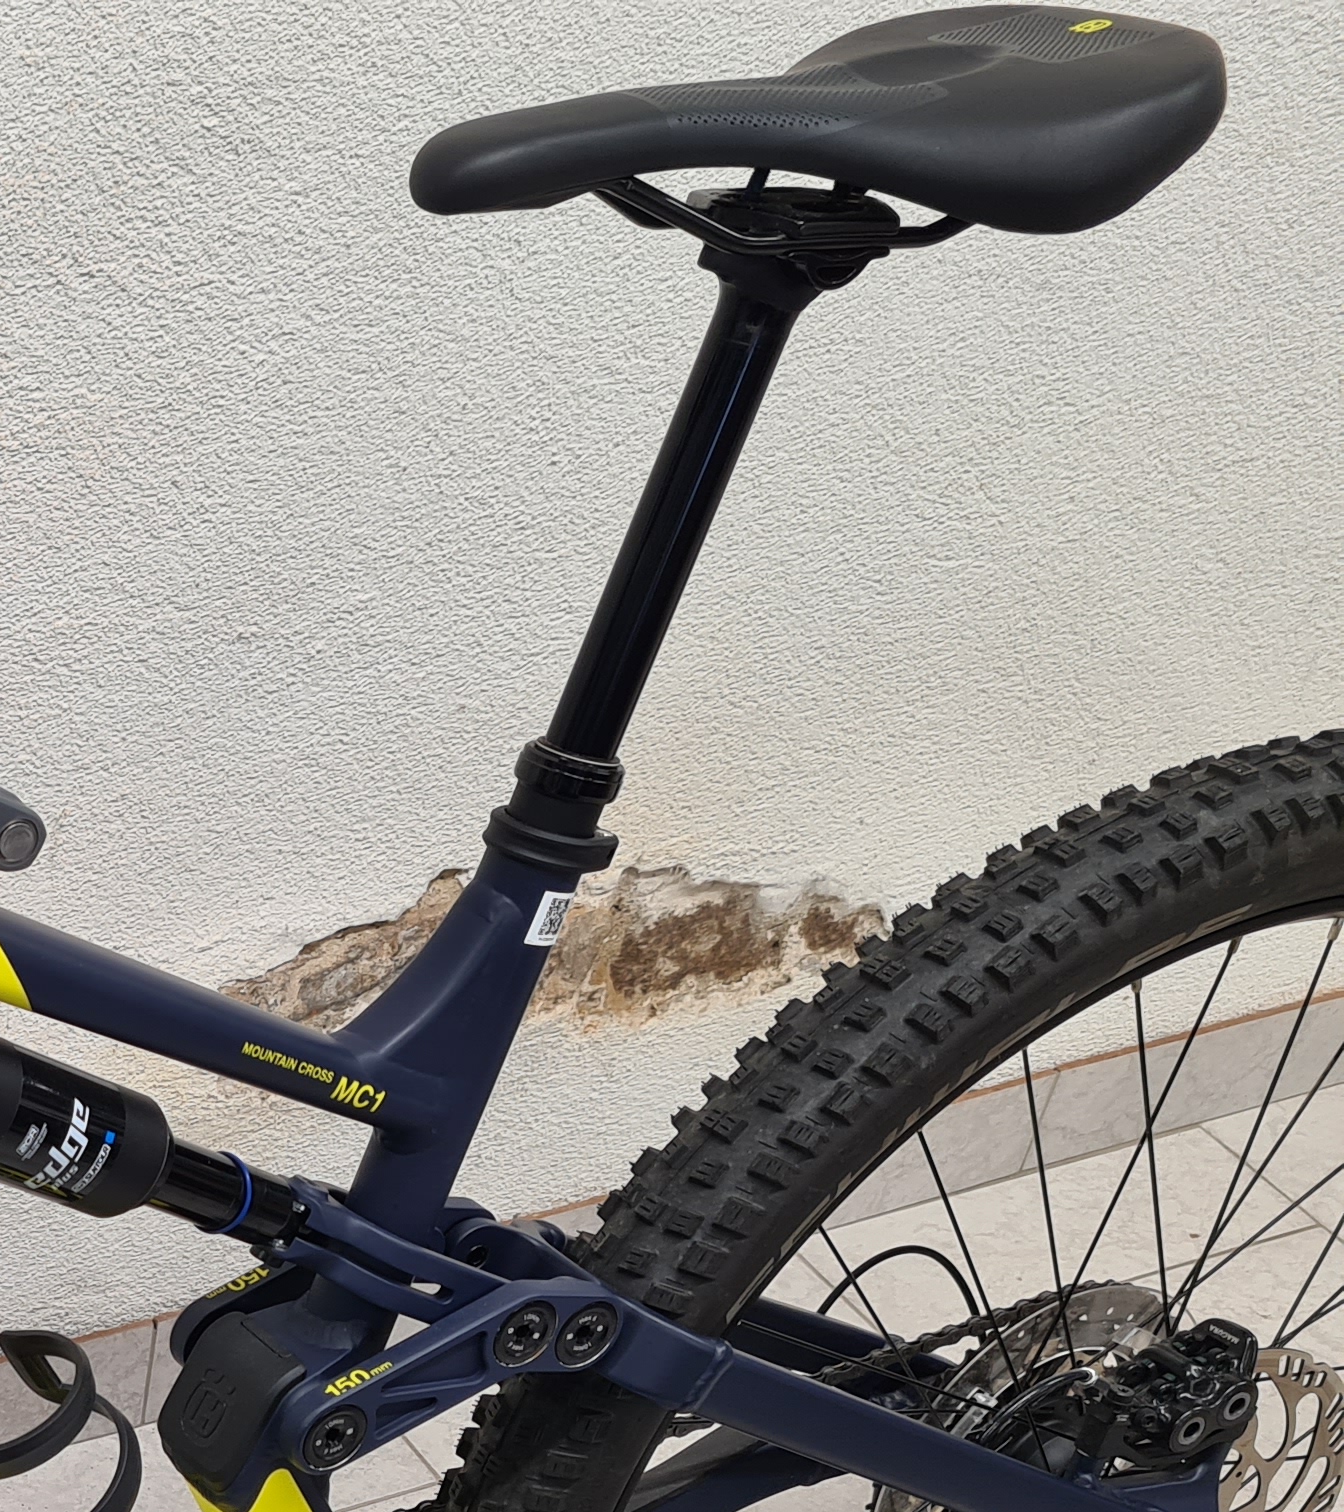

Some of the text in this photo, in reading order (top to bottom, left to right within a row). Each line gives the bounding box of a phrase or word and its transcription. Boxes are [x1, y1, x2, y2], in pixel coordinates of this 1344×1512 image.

[242, 1041, 387, 1115] MOUNTAIN CROSS MC1
[23, 1097, 90, 1190] edge
[227, 1268, 270, 1292] 150
[323, 1360, 394, 1398] 150 mm
